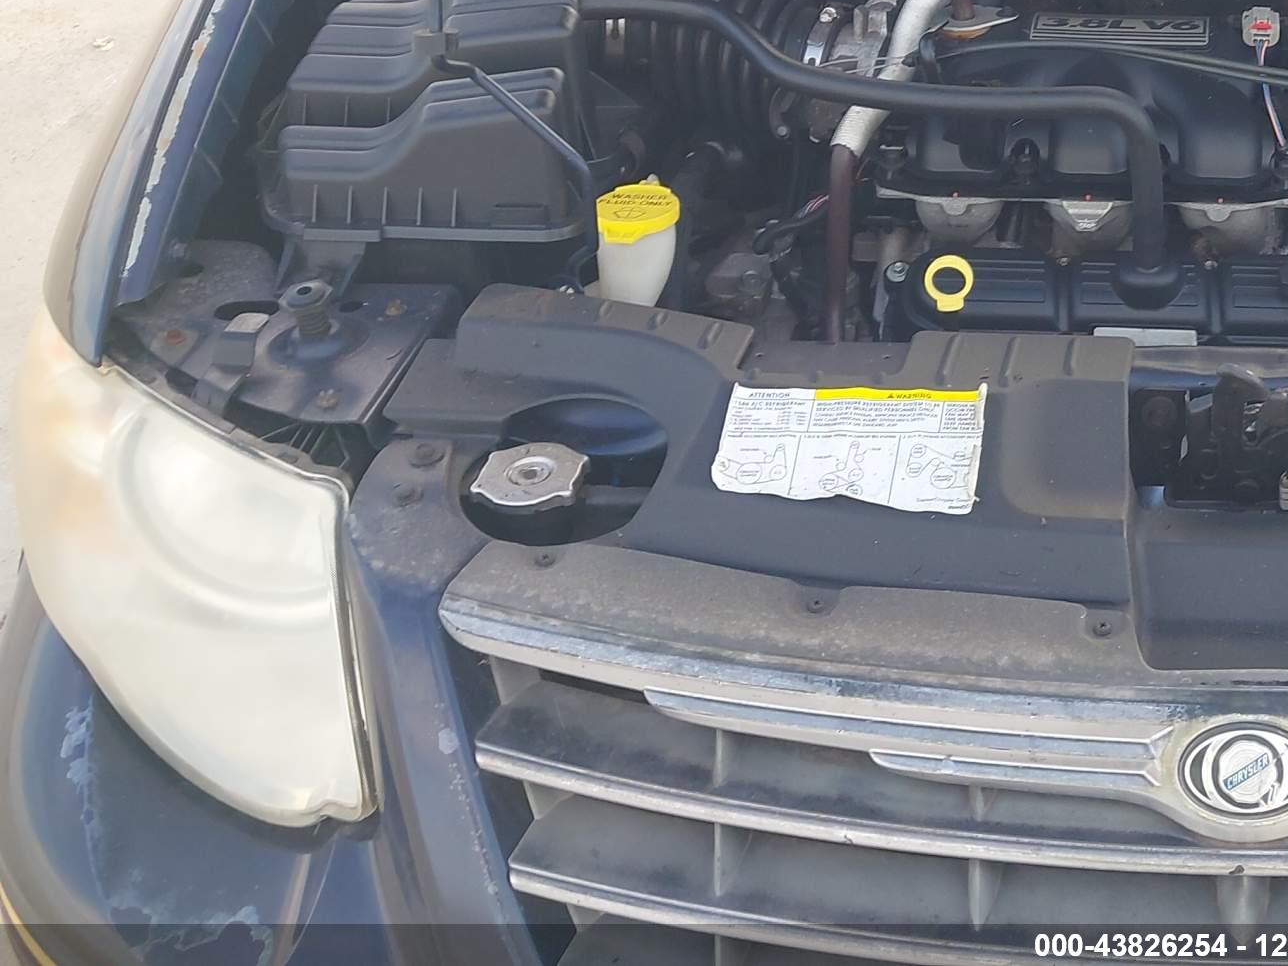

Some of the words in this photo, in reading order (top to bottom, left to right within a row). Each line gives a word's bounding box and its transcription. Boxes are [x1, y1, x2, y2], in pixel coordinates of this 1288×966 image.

[1041, 18, 1135, 30] 3.8L
[1143, 19, 1201, 31] V6
[639, 199, 673, 207] ONLY
[1226, 753, 1269, 790] CHRYSLER
